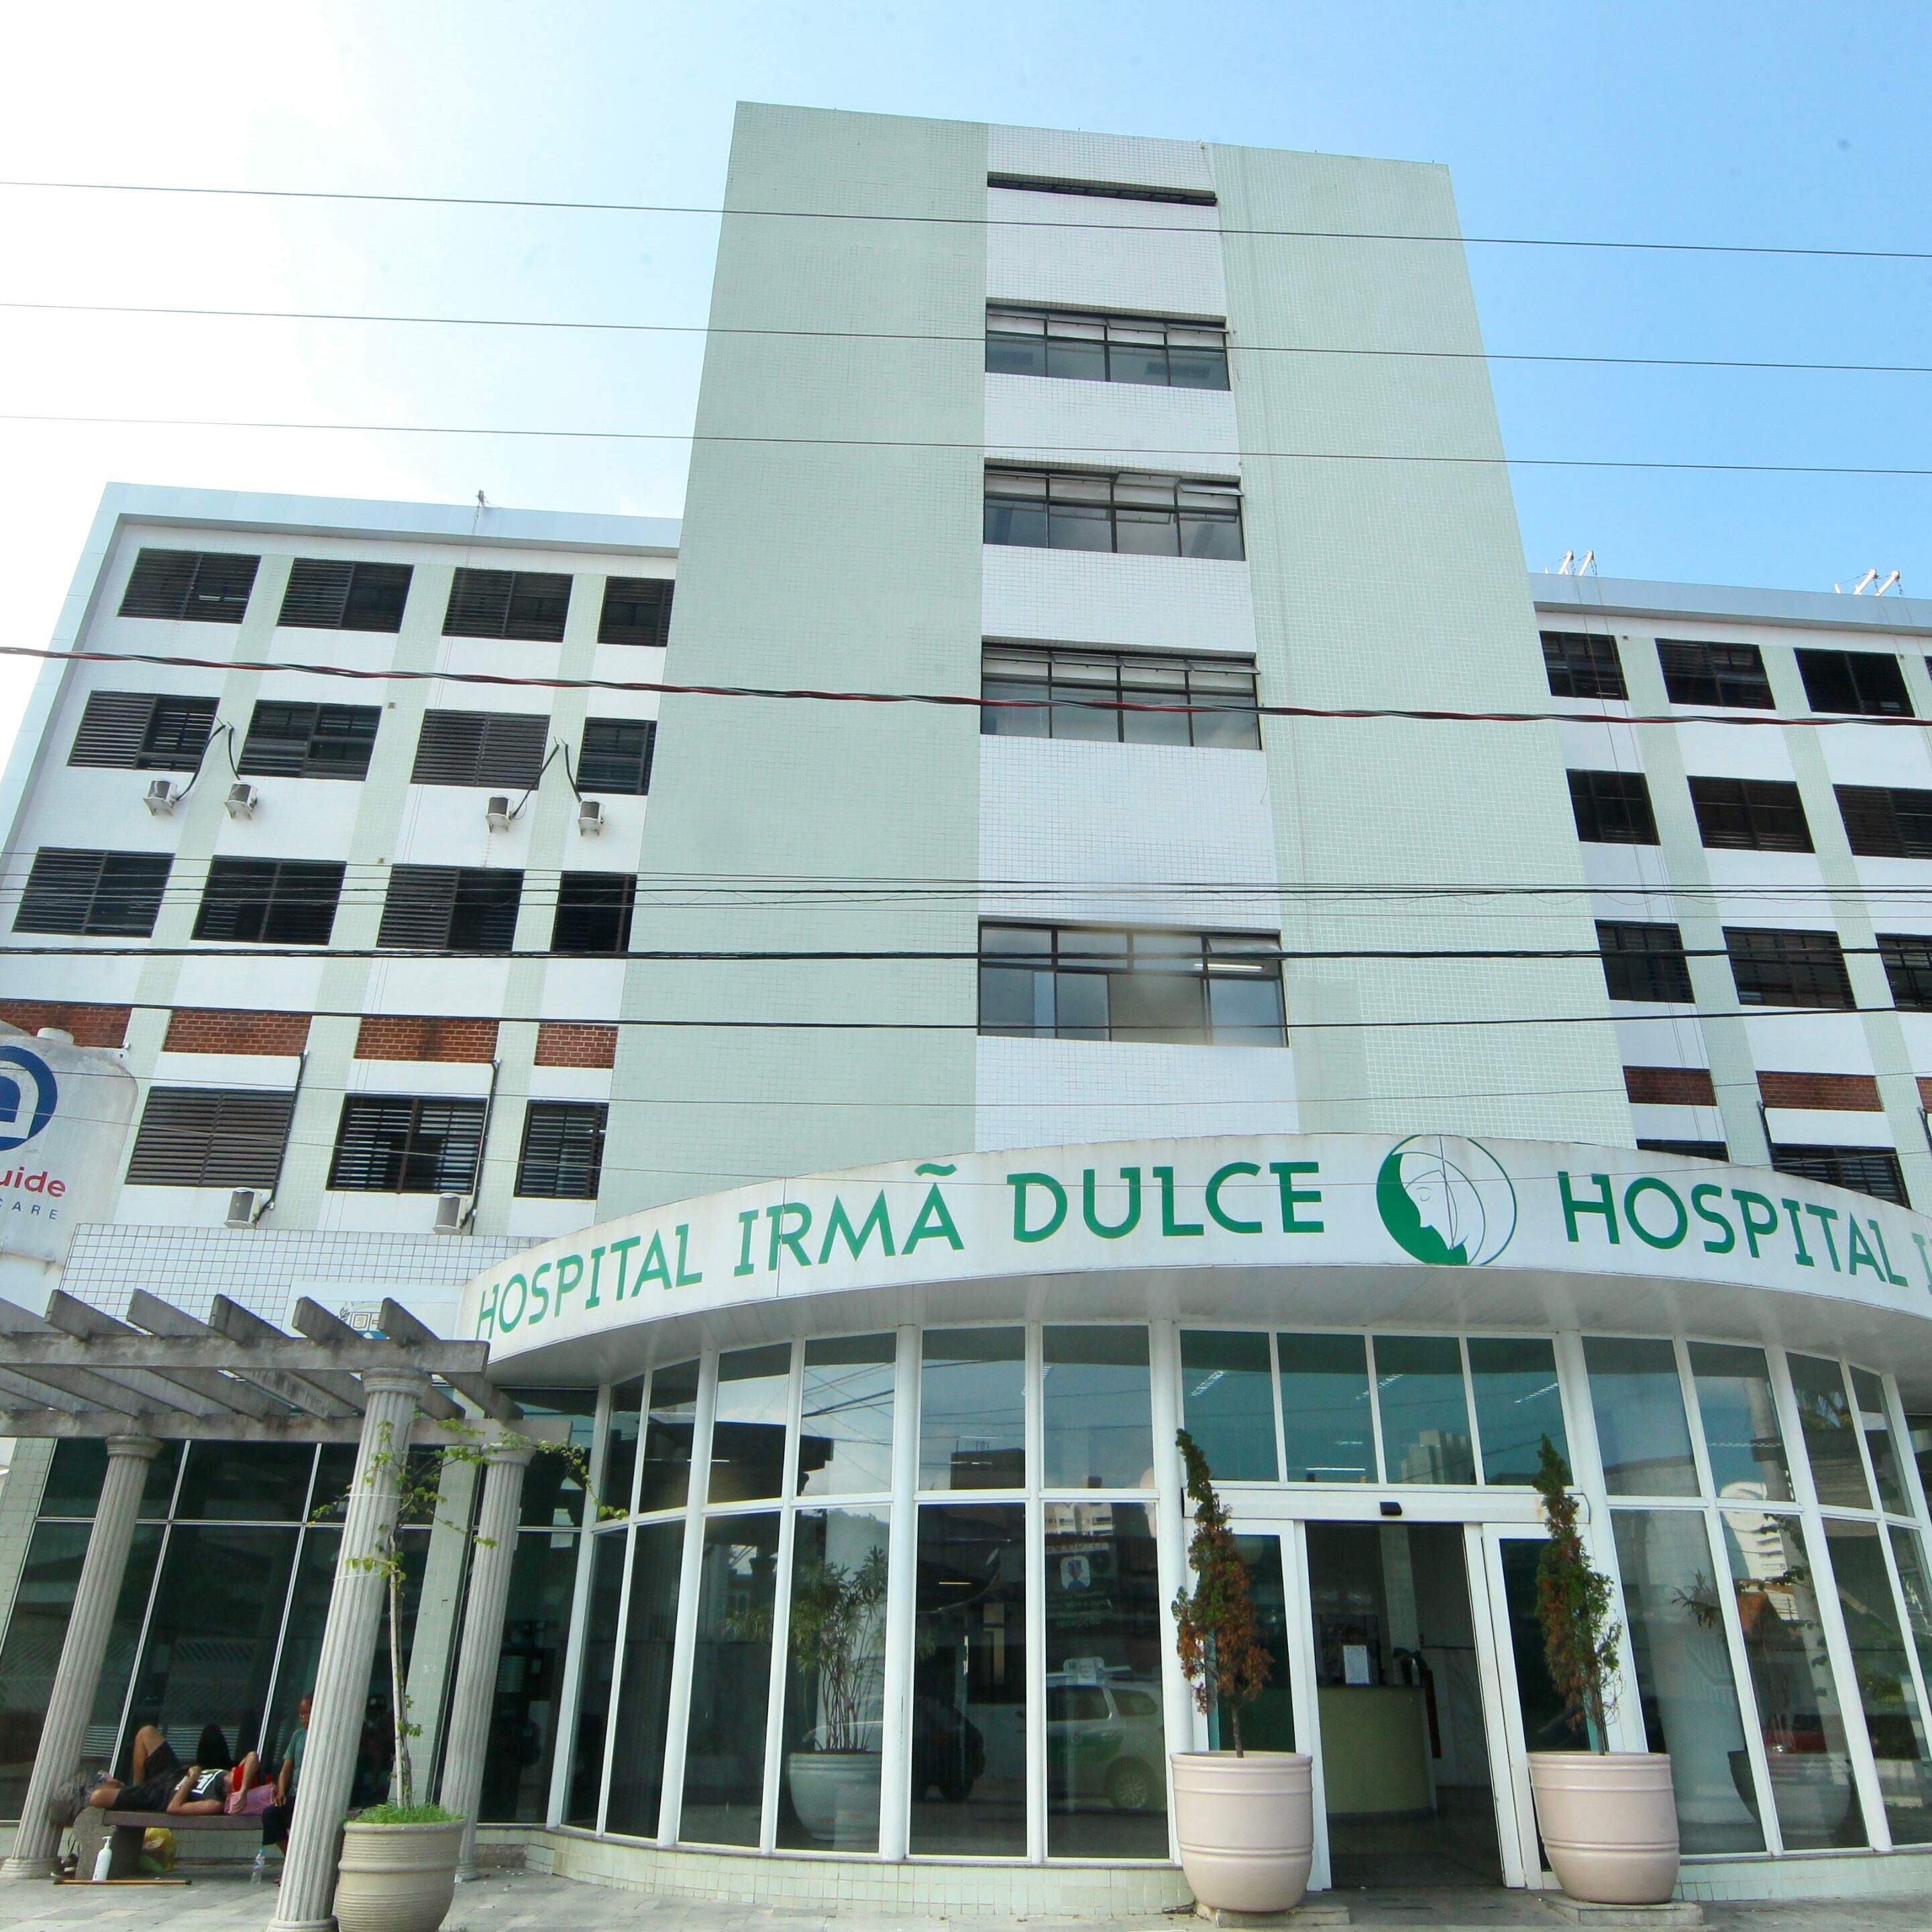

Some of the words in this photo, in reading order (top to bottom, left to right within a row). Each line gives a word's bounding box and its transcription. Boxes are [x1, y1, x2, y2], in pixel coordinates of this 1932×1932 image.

[476, 1224, 703, 1340] HOSPITAL
[733, 1162, 965, 1278] IRMÃ
[1006, 1161, 1325, 1243] DULCE
[1558, 1171, 1909, 1287] HOSPITAL
